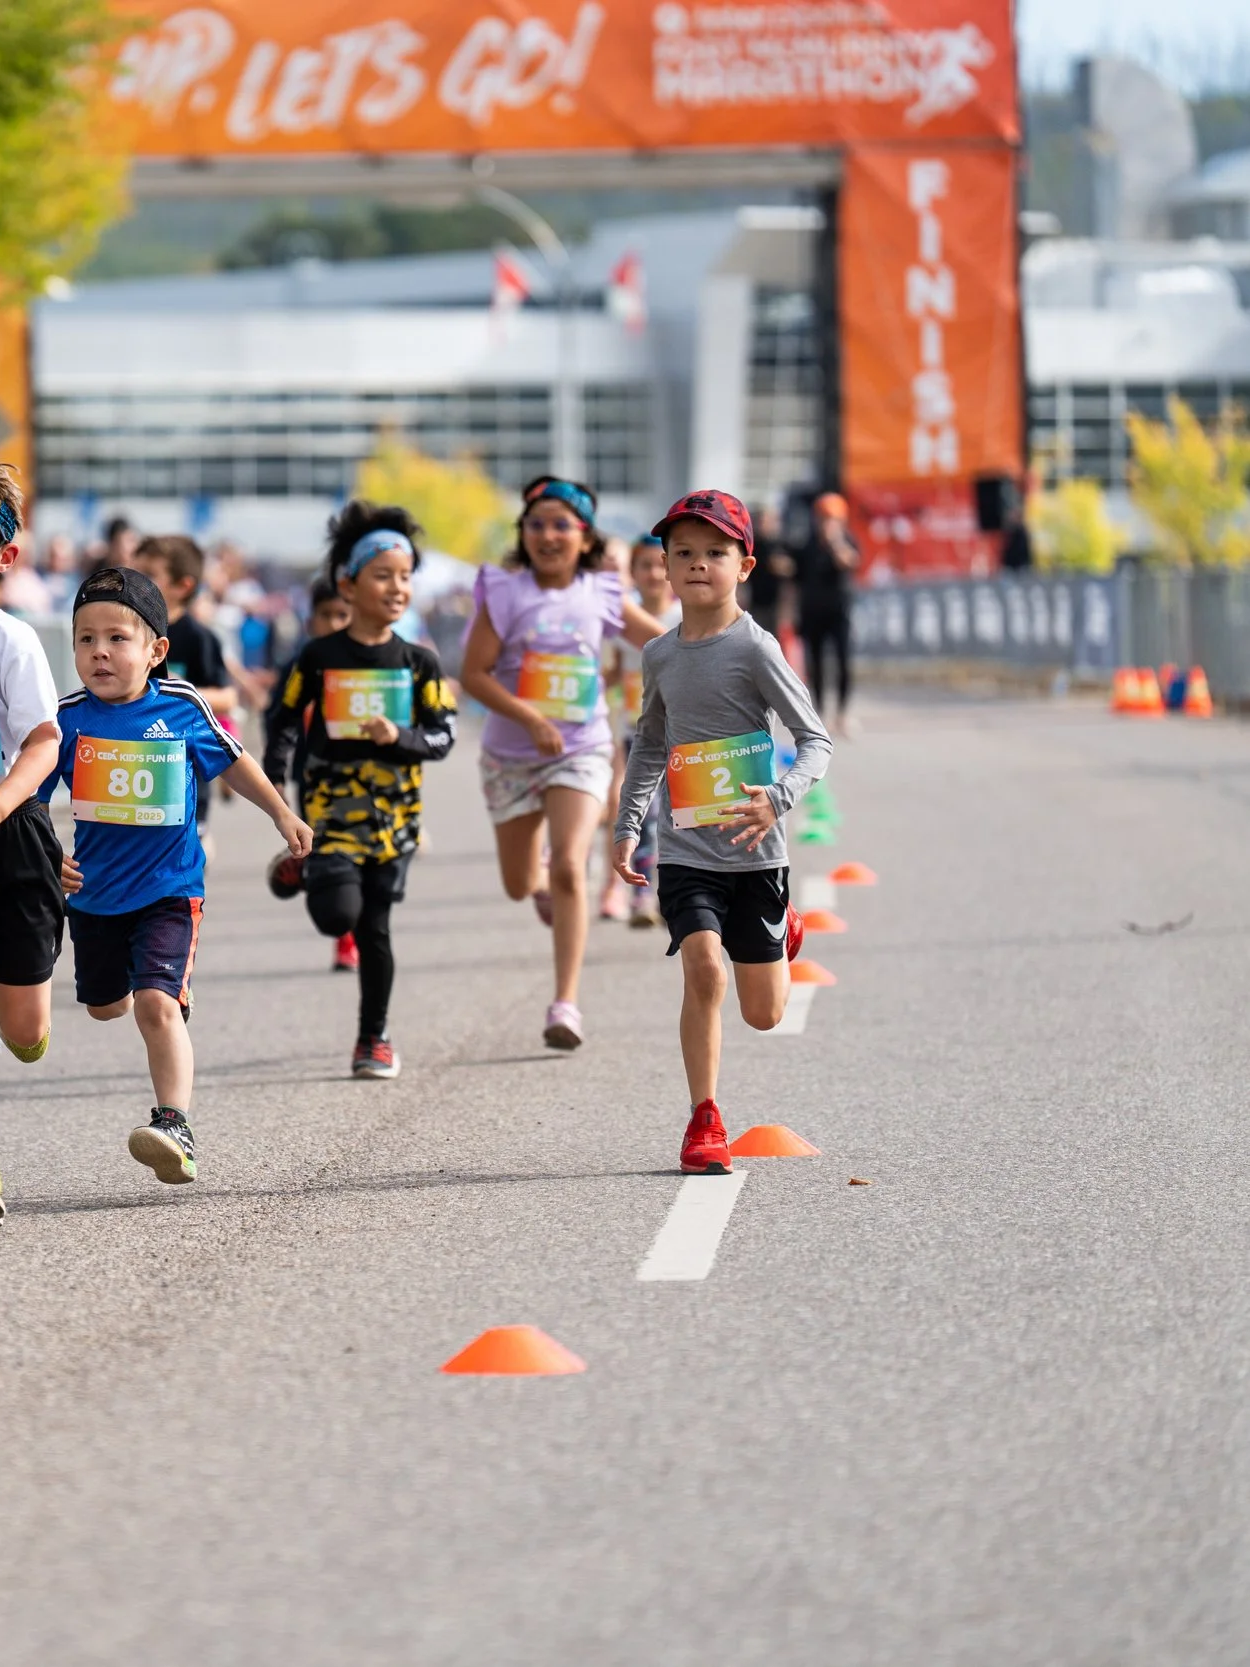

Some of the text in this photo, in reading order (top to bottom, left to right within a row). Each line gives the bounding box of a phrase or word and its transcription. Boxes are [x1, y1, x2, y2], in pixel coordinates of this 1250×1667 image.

[225, 18, 428, 143] LET'S
[438, 1, 606, 127] GO!
[907, 159, 959, 475] FINISH
[349, 692, 386, 718] 85
[143, 730, 174, 739] adidas
[119, 753, 145, 762] KID'S
[146, 754, 166, 763] FUN
[167, 753, 184, 763] RUN
[704, 751, 730, 763] KID'S
[730, 747, 750, 758] FUN
[751, 742, 771, 754] RUN
[108, 768, 154, 798] 80
[710, 767, 735, 797] 2
[137, 811, 162, 821] 2025
